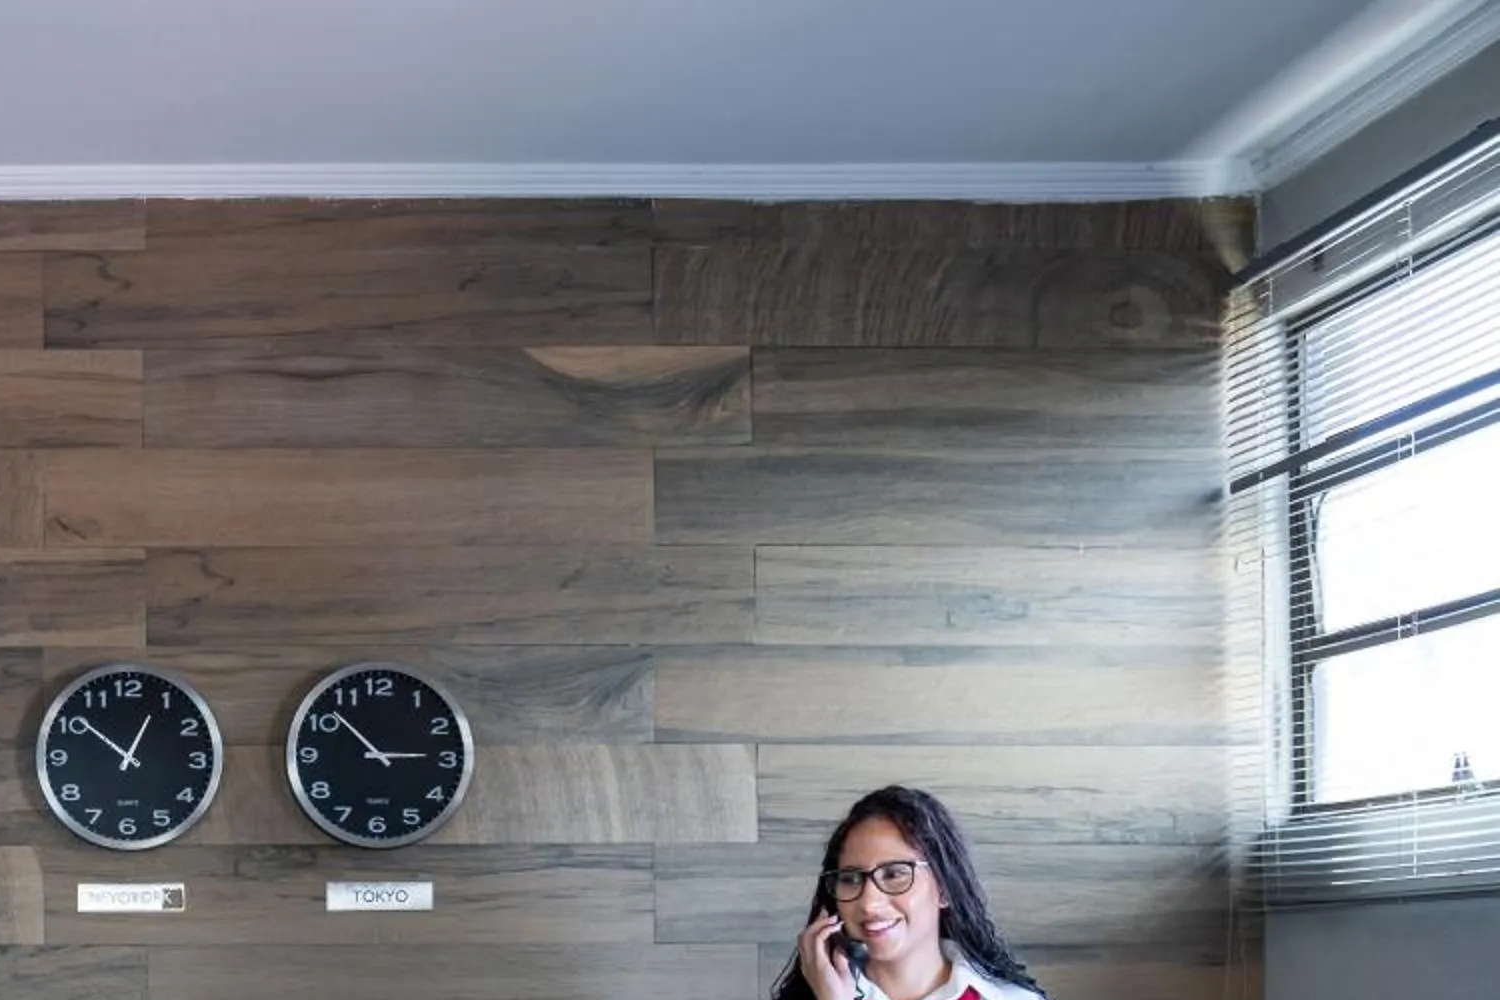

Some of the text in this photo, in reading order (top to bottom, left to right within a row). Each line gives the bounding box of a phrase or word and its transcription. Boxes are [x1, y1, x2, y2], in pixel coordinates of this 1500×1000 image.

[113, 679, 143, 698] 12
[364, 677, 394, 696] 12
[83, 690, 108, 709] 11
[161, 691, 171, 709] 1
[334, 687, 358, 707] 11
[412, 690, 422, 709] 1
[58, 716, 89, 735] 10
[180, 718, 199, 737] 2
[309, 713, 340, 733] 10
[430, 716, 449, 735] 2
[50, 749, 69, 767] 9
[188, 751, 207, 769] 3
[300, 747, 319, 764] 9
[438, 751, 458, 769] 3
[60, 783, 81, 801] 8
[175, 787, 194, 803] 4
[310, 781, 331, 799] 8
[425, 785, 444, 801] 4
[84, 808, 103, 825] 7
[152, 809, 171, 826] 5
[333, 806, 353, 823] 7
[402, 808, 421, 825] 5
[118, 818, 137, 835] 6
[368, 816, 387, 833] 6
[354, 889, 409, 903] TOKYO
